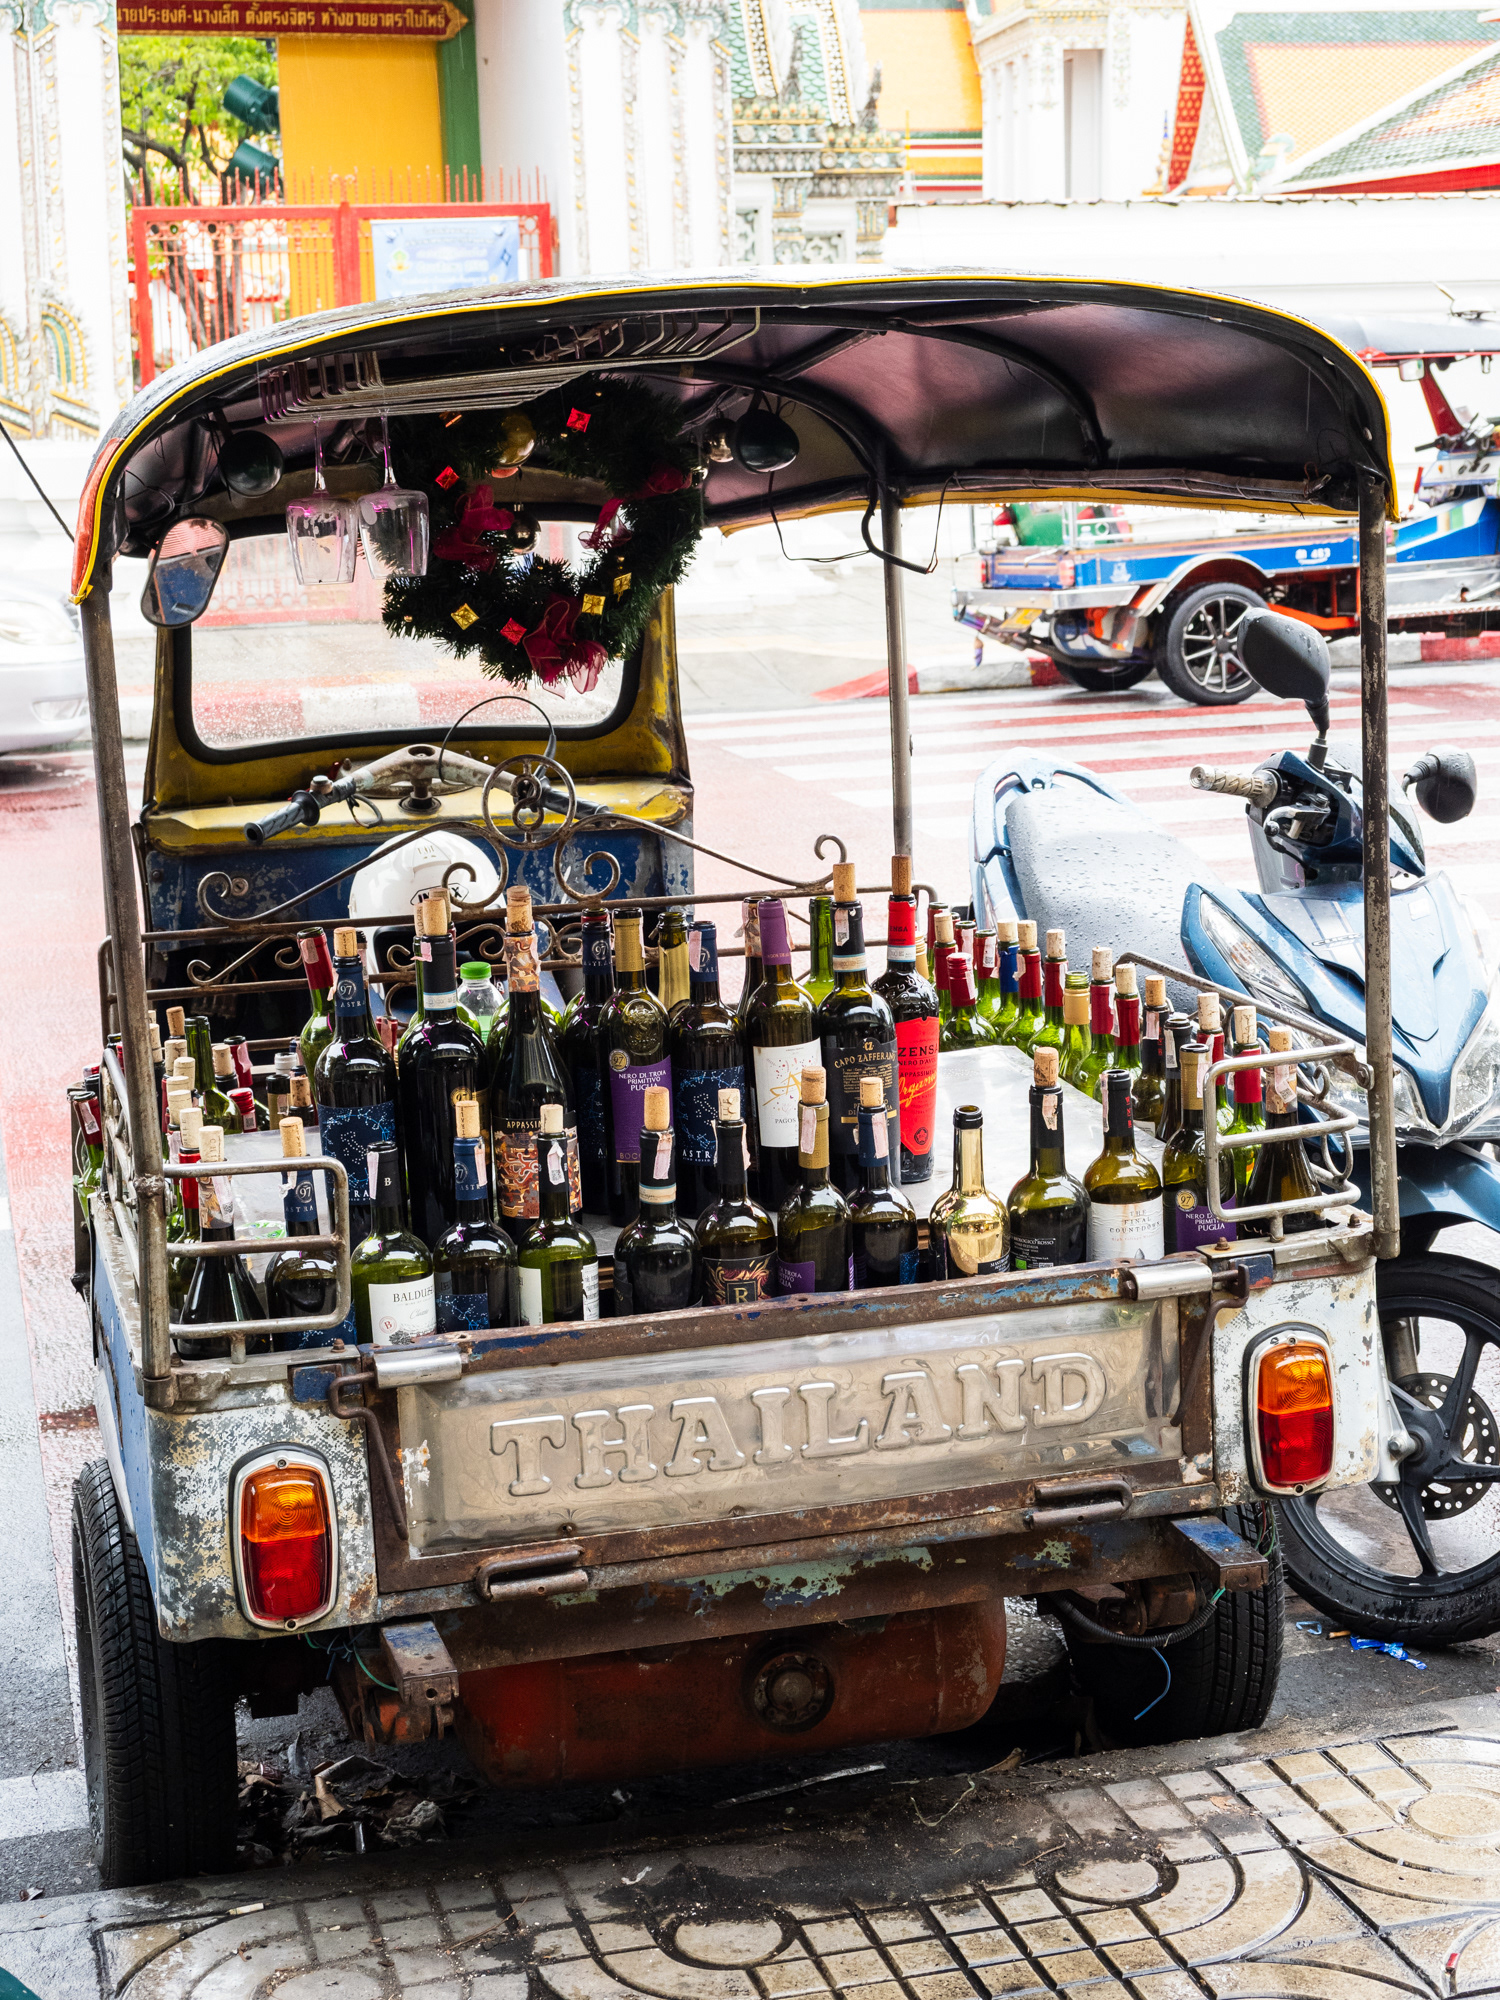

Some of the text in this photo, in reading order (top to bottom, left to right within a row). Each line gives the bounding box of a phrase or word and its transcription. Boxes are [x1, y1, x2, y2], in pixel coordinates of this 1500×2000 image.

[595, 945, 606, 956] 97
[340, 985, 352, 996] 97
[834, 1056, 856, 1068] CAPO
[627, 1076, 661, 1084] PRIMITIVO
[682, 1149, 712, 1159] ASTR
[384, 1177, 392, 1187] B
[299, 1186, 311, 1197] 97
[1124, 1217, 1151, 1225] FINAL
[1198, 1223, 1226, 1231] PUGLIA
[734, 1287, 749, 1304] R
[489, 1351, 1109, 1496] THAILAND
